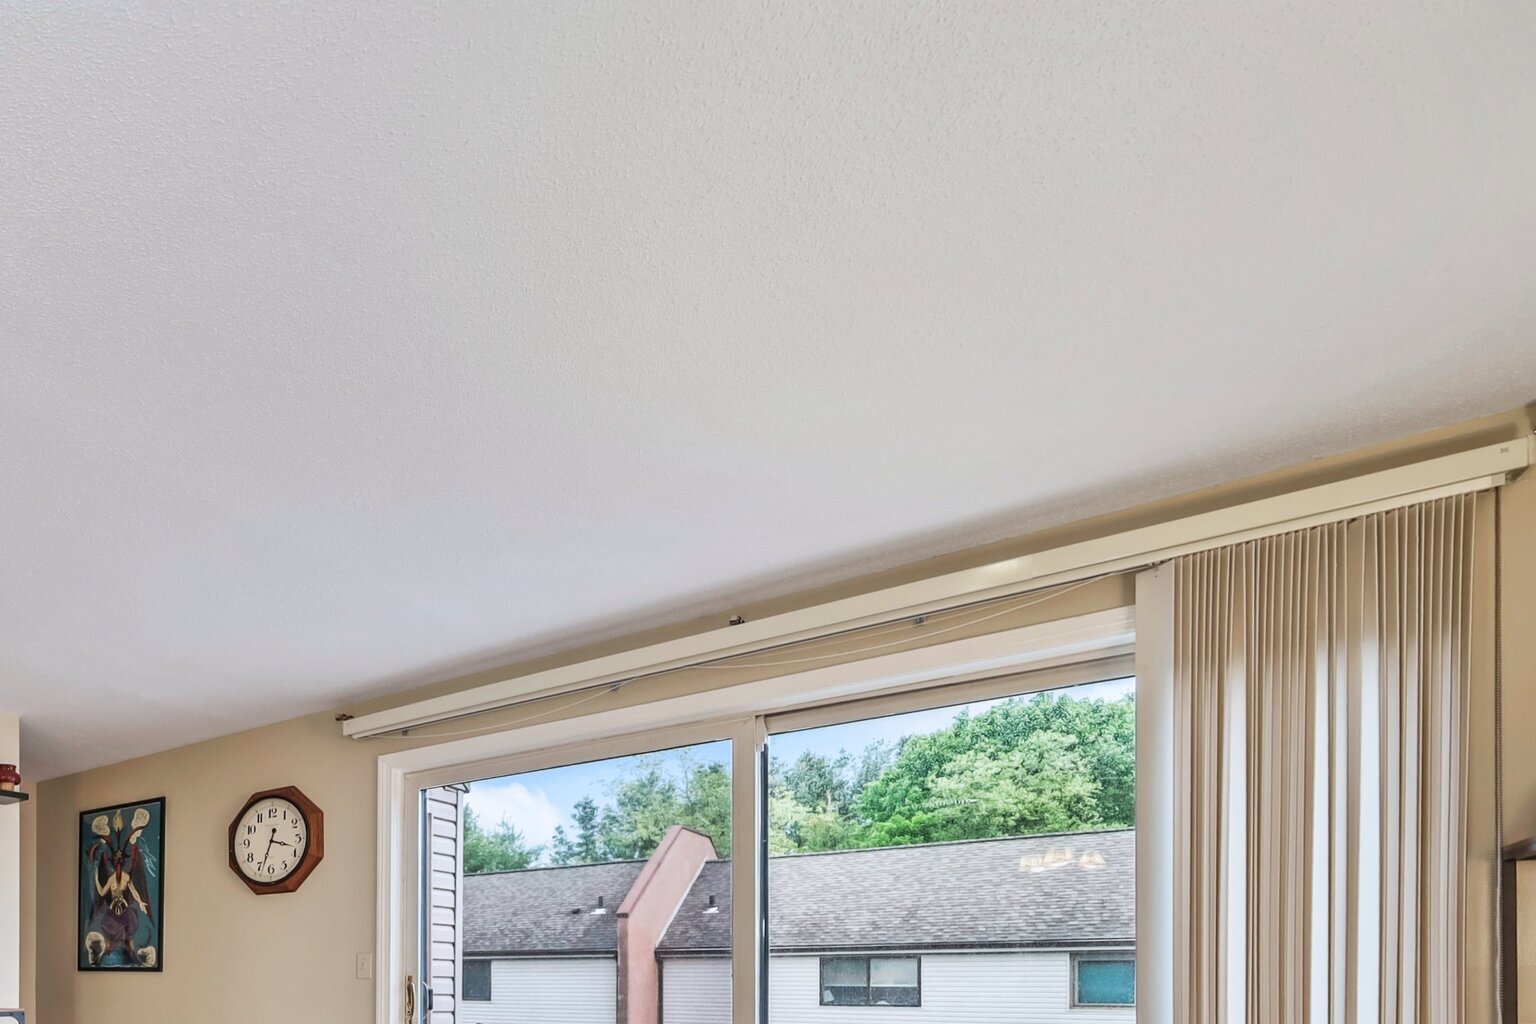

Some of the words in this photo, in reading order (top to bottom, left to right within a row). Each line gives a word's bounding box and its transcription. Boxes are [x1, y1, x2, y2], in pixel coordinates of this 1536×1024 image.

[268, 807, 277, 818] 12
[257, 813, 263, 823] 11
[291, 818, 298, 829] 2
[247, 825, 256, 835] 10
[243, 838, 250, 848] 9
[246, 852, 254, 863] 8
[257, 862, 263, 872] 7
[267, 864, 275, 875] 6
[280, 860, 288, 870] 5
